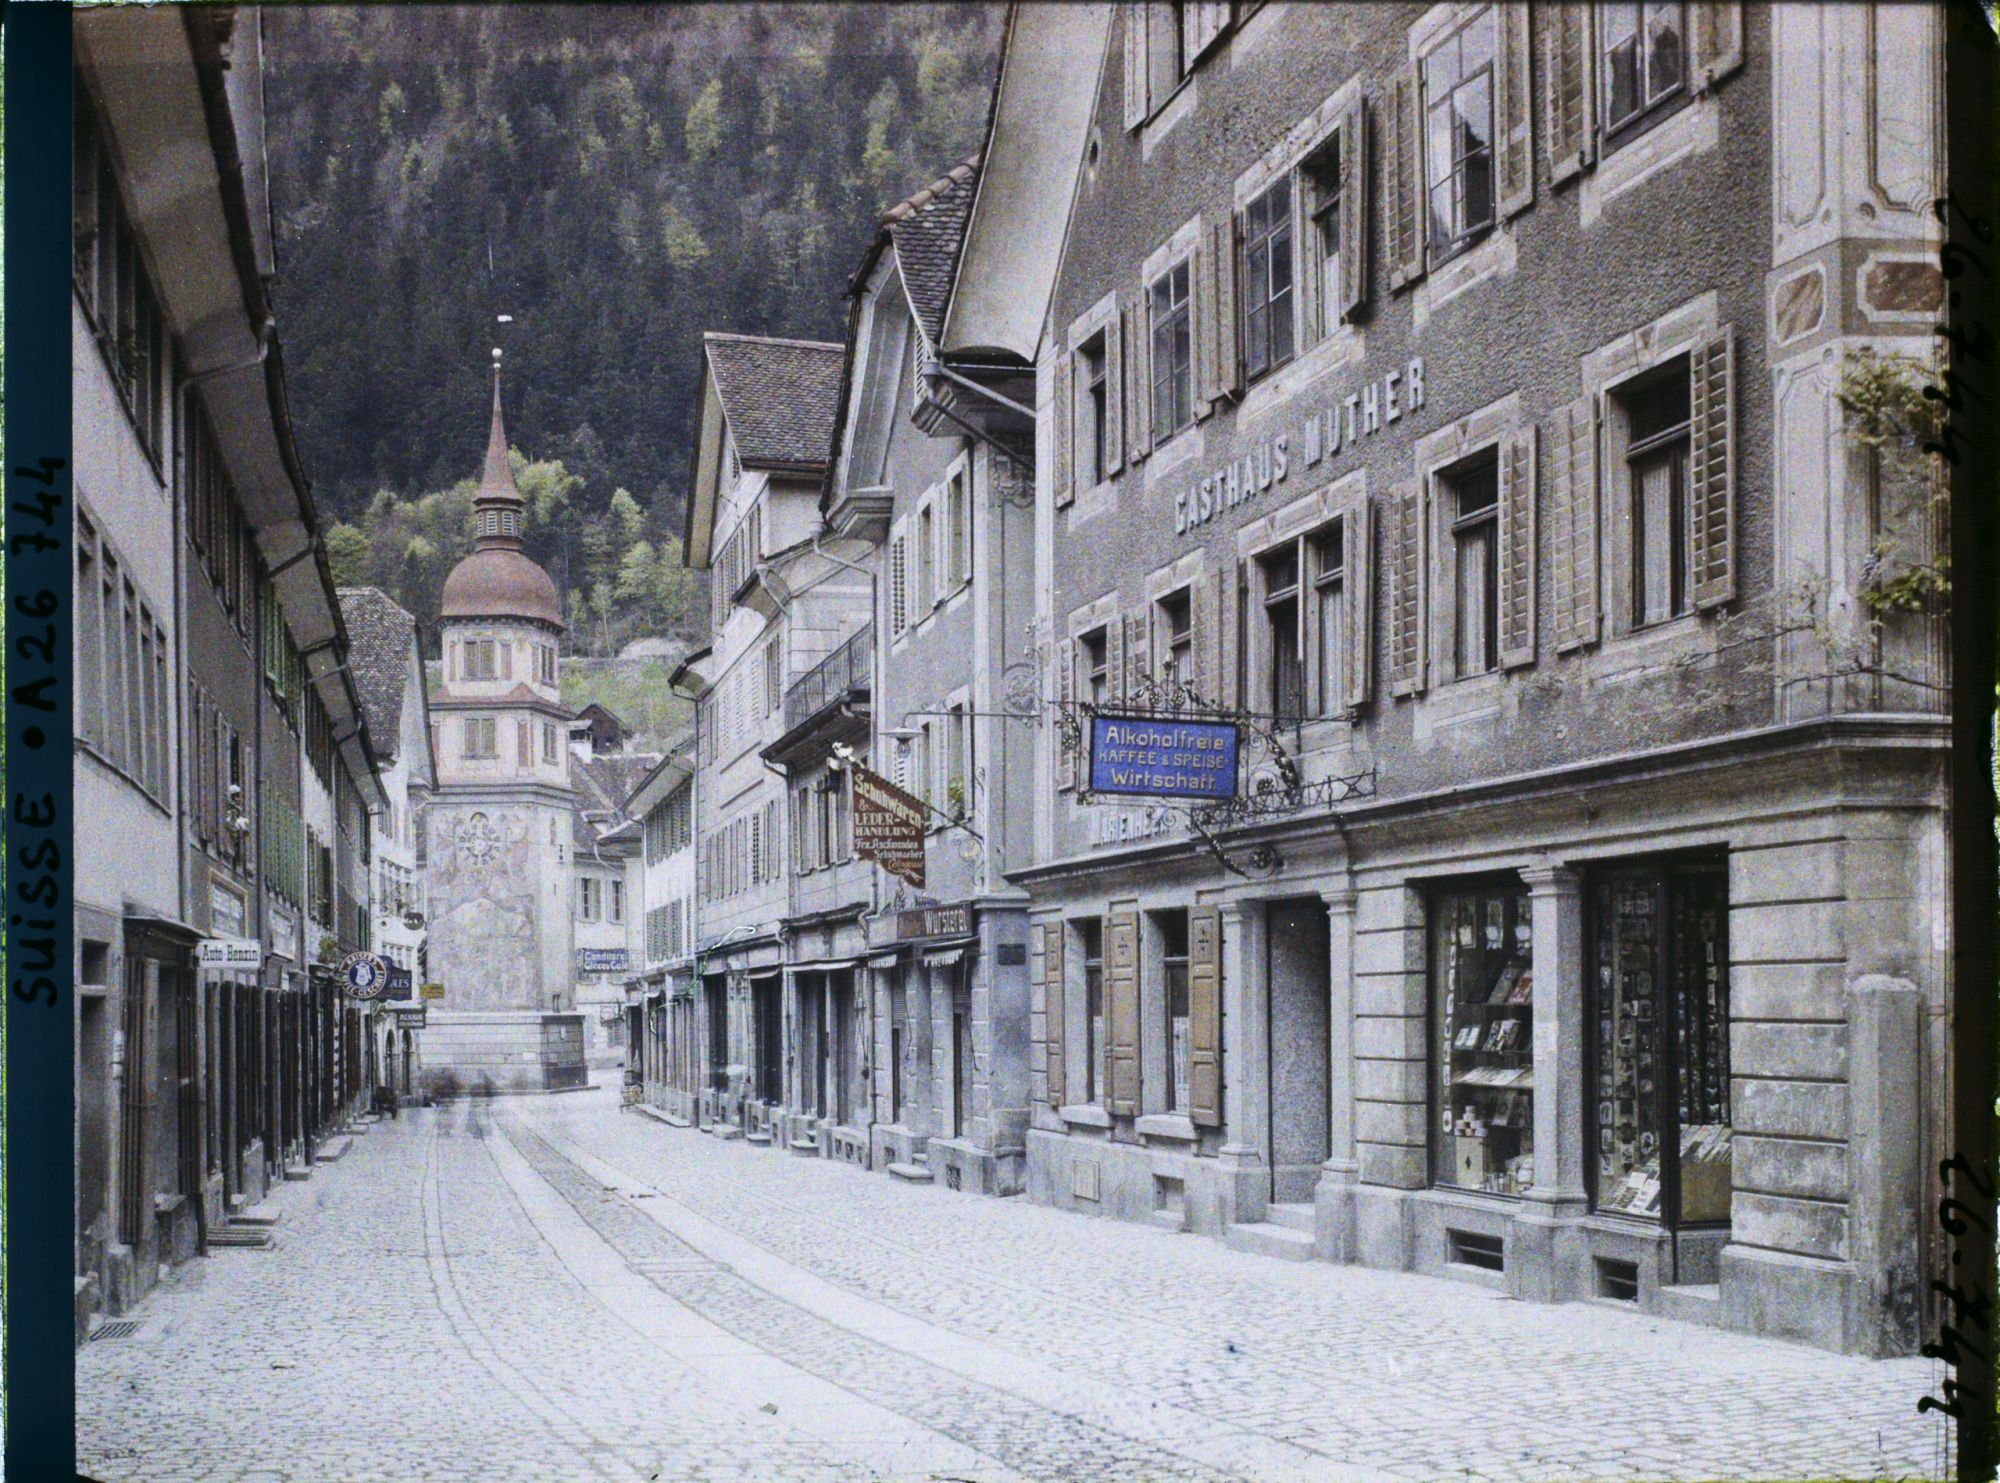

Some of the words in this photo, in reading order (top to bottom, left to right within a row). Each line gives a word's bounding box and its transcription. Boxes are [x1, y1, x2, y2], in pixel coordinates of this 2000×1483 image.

[1174, 433, 1289, 535] GASTHAUS
[1304, 356, 1426, 470] MUTHER
[1105, 725, 1225, 751] Alkoholfreie
[1099, 749, 1157, 767] KAFFEE
[1161, 755, 1170, 766] &
[1110, 768, 1216, 791] Wirtschaft
[854, 812, 901, 826] LEDER-
[854, 826, 916, 837] HANDLUNG
[923, 905, 968, 935] Wursterei
